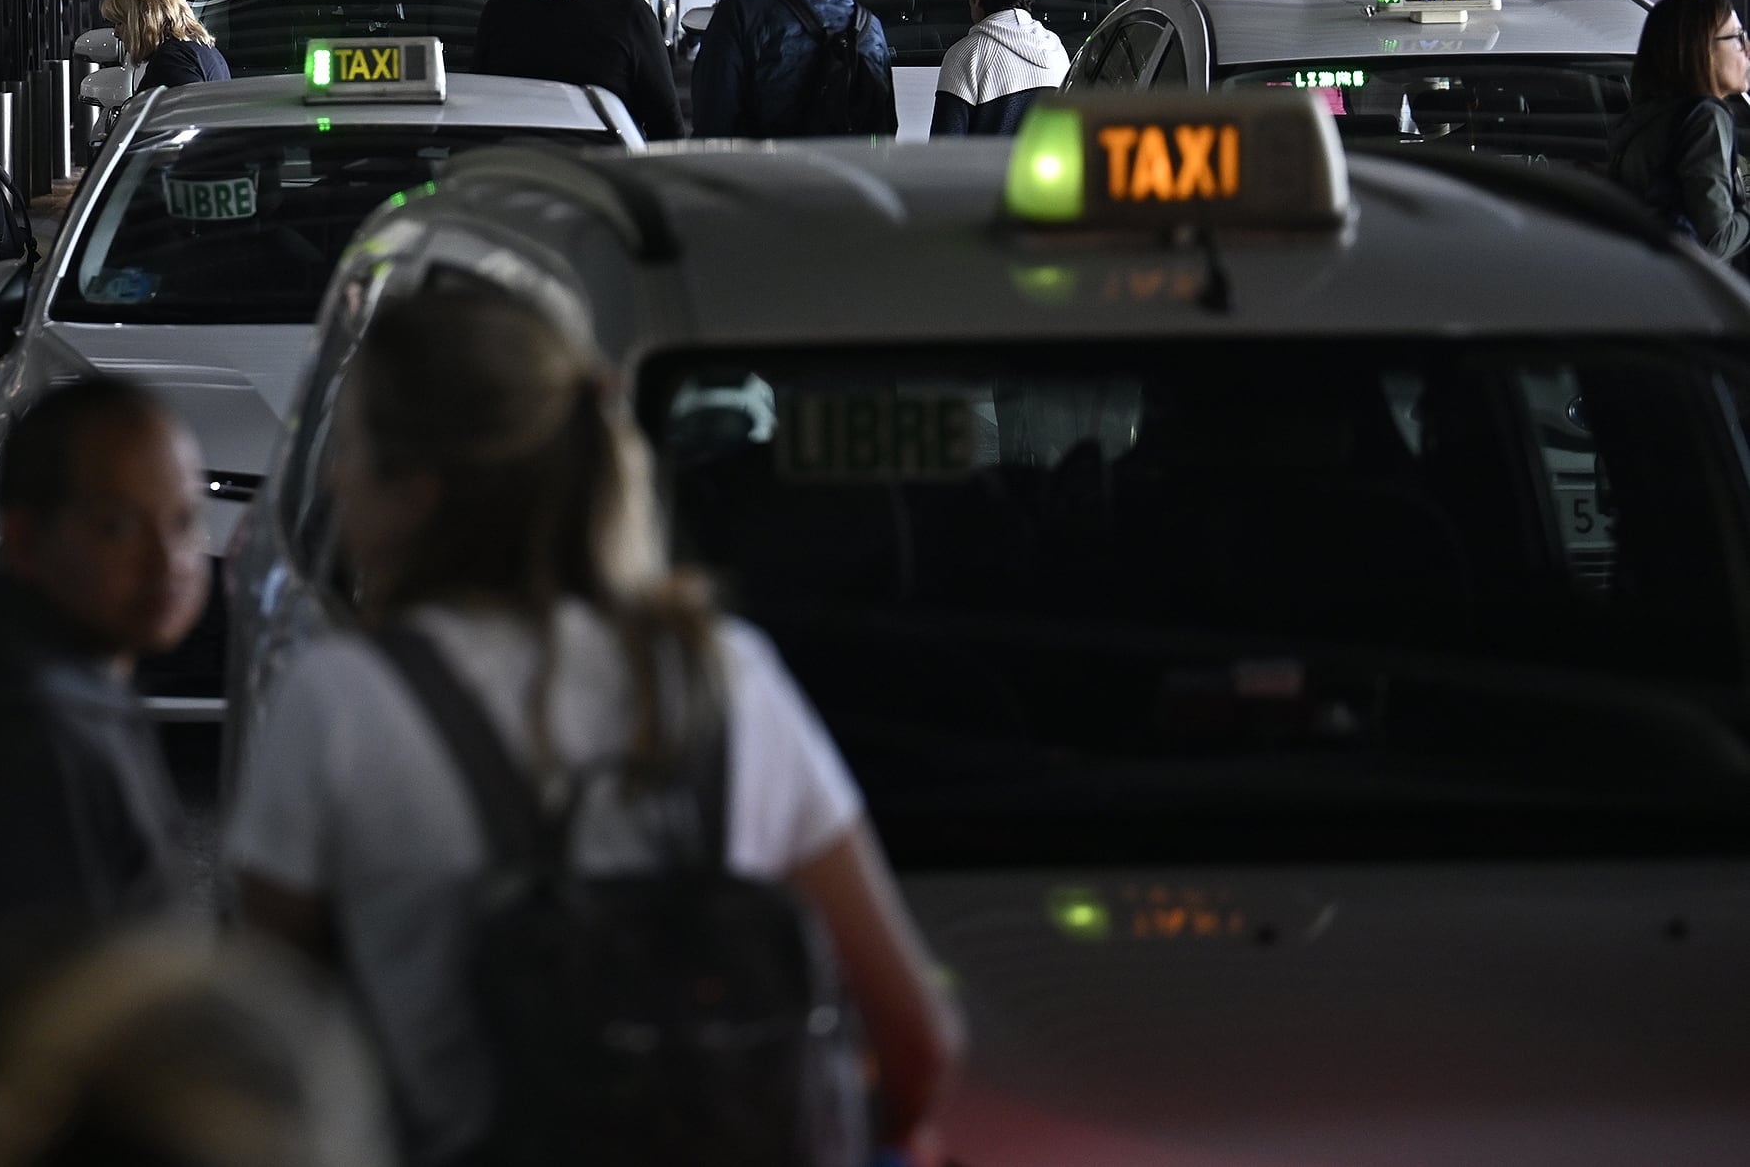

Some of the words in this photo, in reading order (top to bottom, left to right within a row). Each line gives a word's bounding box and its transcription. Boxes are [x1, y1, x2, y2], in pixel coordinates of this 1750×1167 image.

[334, 48, 400, 81] TAXI
[1098, 122, 1241, 202] TAXI
[169, 181, 251, 218] LIBRE
